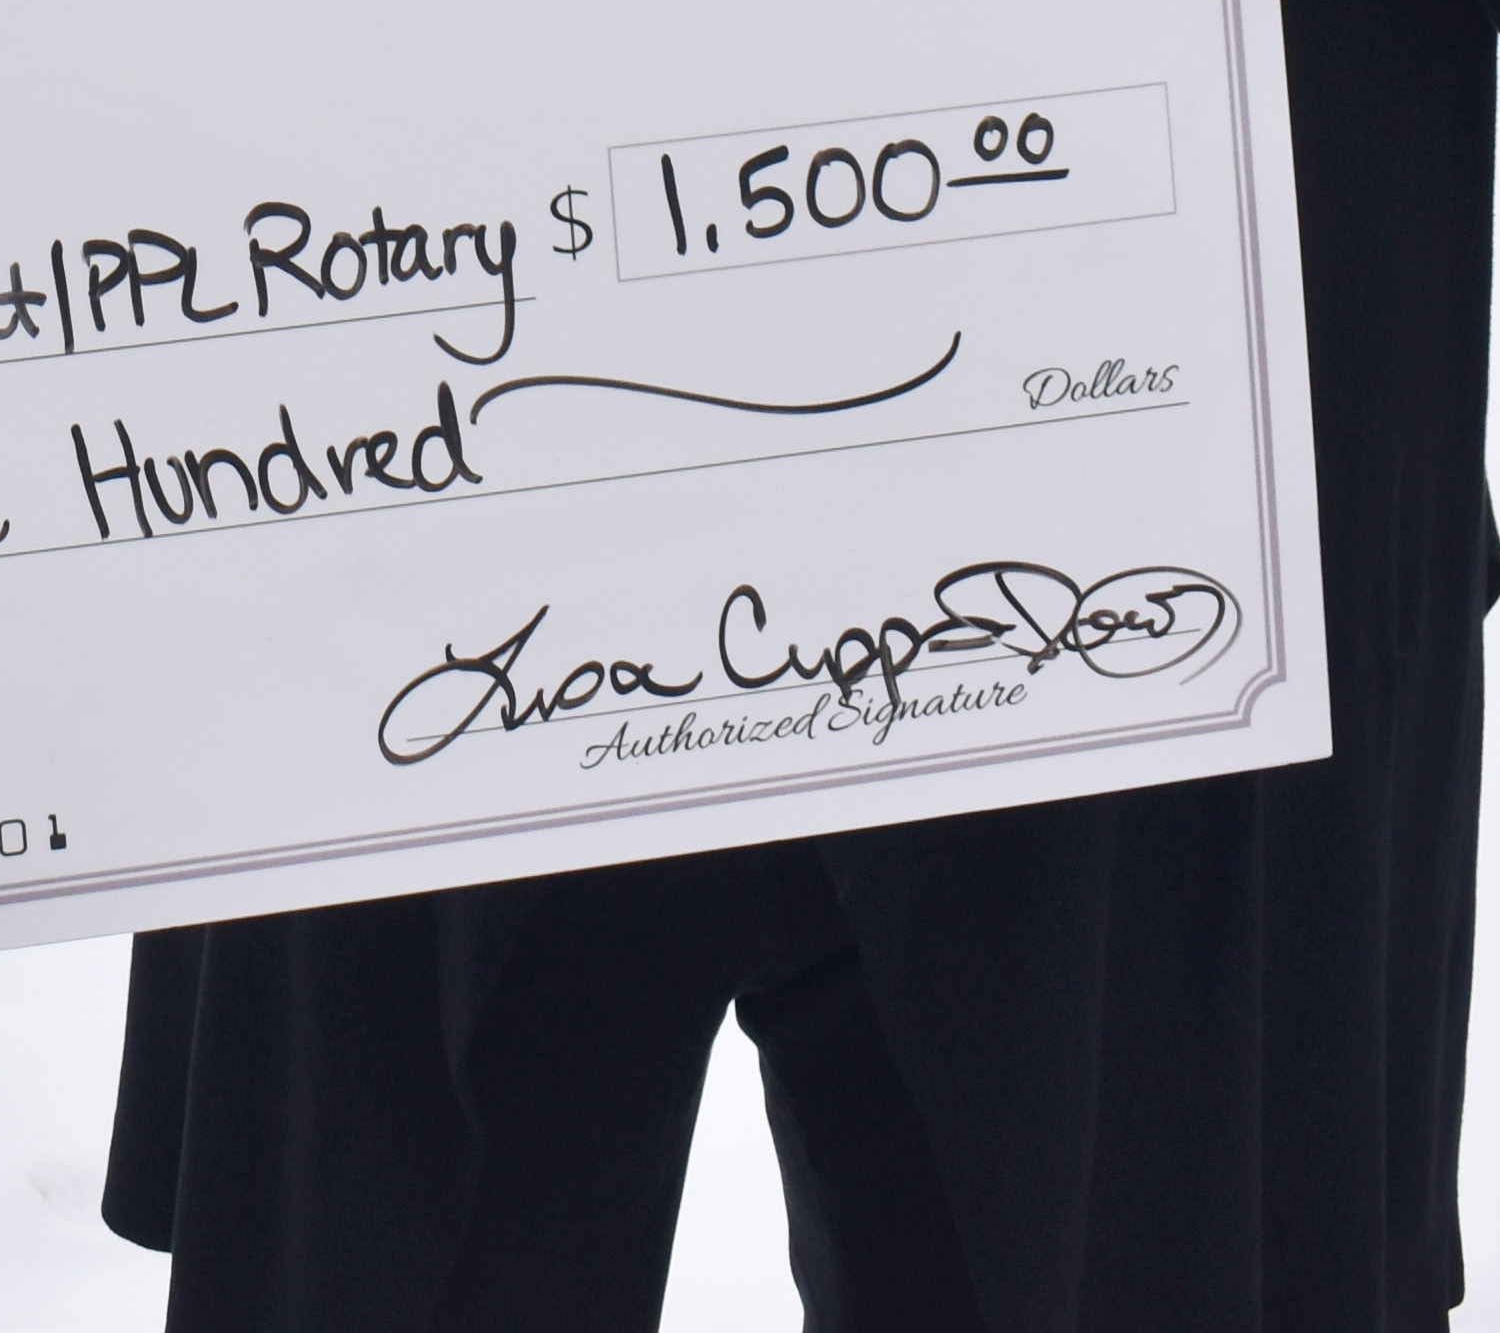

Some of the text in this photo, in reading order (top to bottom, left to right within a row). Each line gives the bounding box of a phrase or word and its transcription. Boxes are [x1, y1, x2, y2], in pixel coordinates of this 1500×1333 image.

[549, 185, 594, 261] $
[244, 201, 516, 366] Rotary
[1023, 360, 1180, 412] Dollars
[70, 379, 484, 539] Hundred
[578, 676, 1030, 771] Authorized Signature
